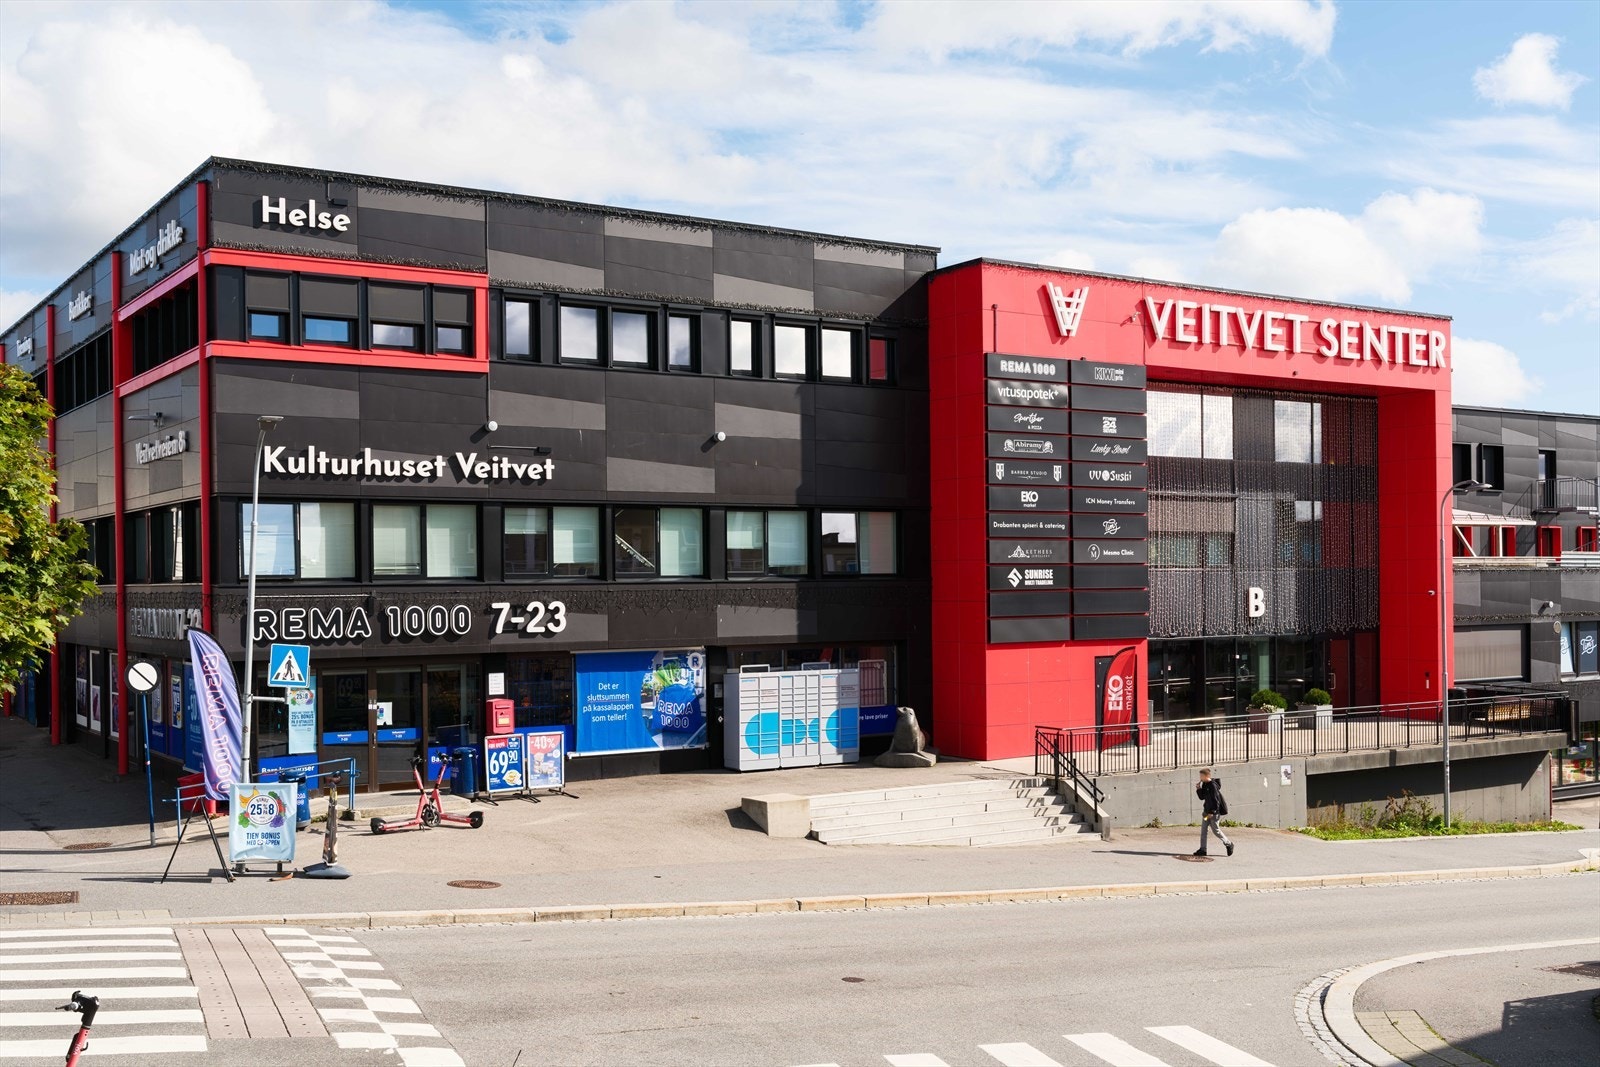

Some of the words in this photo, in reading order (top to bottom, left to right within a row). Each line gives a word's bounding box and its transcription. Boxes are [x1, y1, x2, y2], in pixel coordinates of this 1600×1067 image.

[262, 195, 351, 232] Helse
[129, 248, 146, 277] Mat
[145, 245, 157, 269] og
[157, 219, 183, 257] drikke
[1144, 295, 1309, 353] VEITVET
[1319, 317, 1447, 368] SENTER
[1000, 360, 1031, 374] REMA
[1032, 362, 1056, 376] 1000
[1094, 366, 1115, 381] KIWI
[1102, 421, 1117, 429] 24
[178, 430, 186, 453] 8
[1015, 441, 1043, 449] Abiramy
[264, 445, 446, 478] Kulturhuset
[455, 452, 555, 480] Veitvet
[1021, 491, 1039, 502] EKO
[1096, 498, 1113, 506] Money
[1044, 522, 1065, 530] catering
[1024, 569, 1054, 579] SUNRISE
[1248, 587, 1266, 618] B
[252, 606, 372, 641] REMA
[385, 604, 472, 637] 1000
[491, 600, 568, 635] 7-23
[202, 654, 227, 731] REMA
[598, 683, 611, 691] Det
[1107, 674, 1124, 711] EKO
[1124, 675, 1133, 710] market
[587, 693, 630, 702] sluttsummen
[583, 704, 592, 713] på
[593, 703, 634, 712] kassalappen
[658, 700, 693, 715] REMA
[592, 715, 606, 723] som
[607, 713, 627, 721] teller!
[661, 715, 689, 728] 1000
[875, 713, 889, 721] priser
[530, 735, 556, 749] -40%
[489, 751, 508, 775] 69
[508, 750, 518, 761] 90
[250, 803, 262, 815] 25
[268, 803, 275, 815] 8
[260, 832, 281, 840] BONUS
